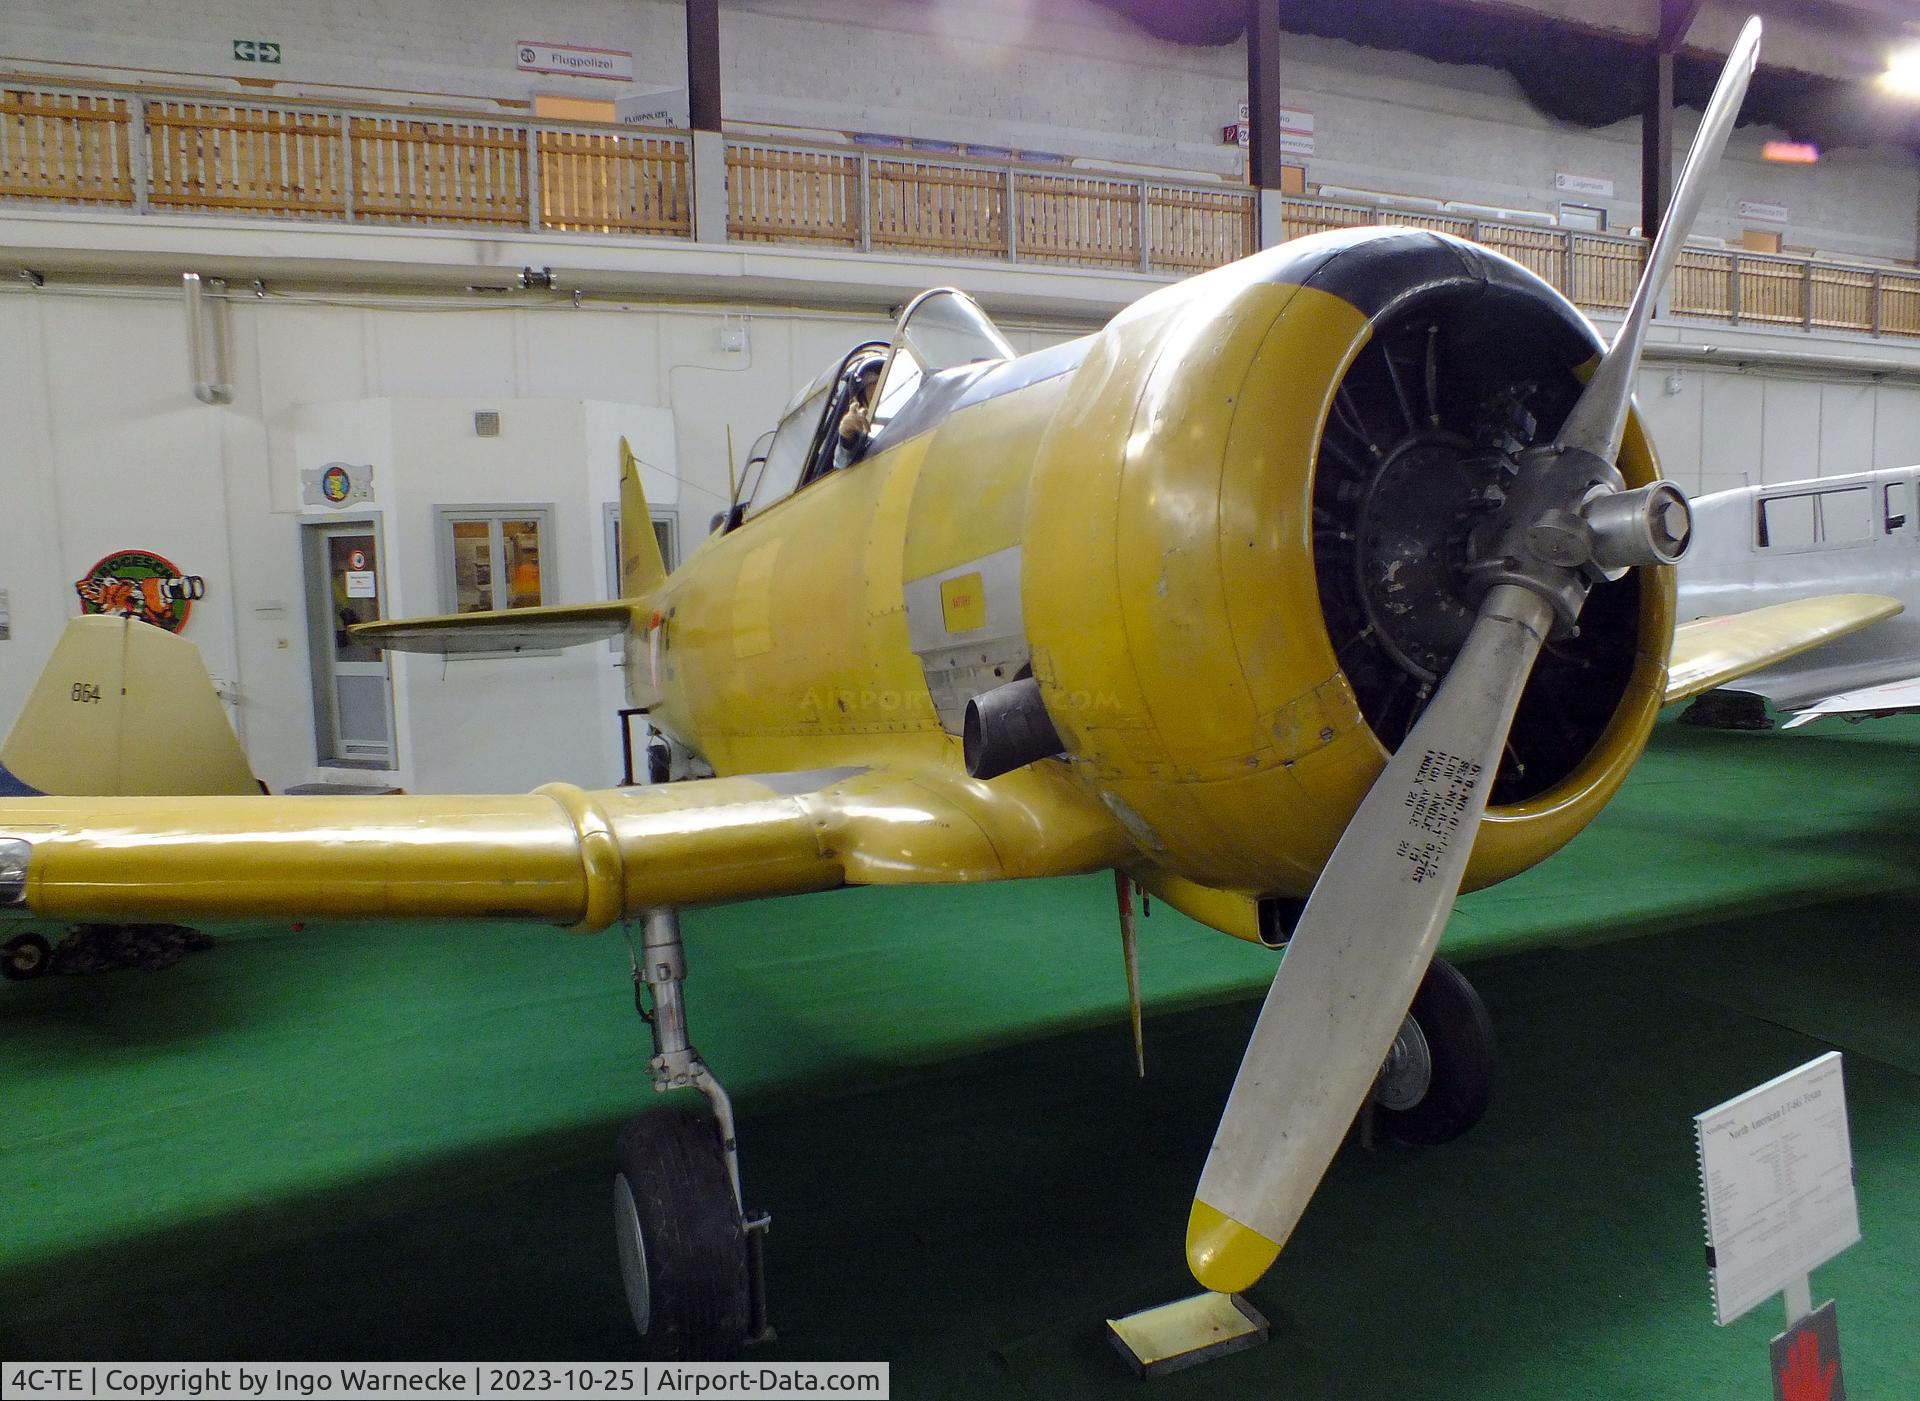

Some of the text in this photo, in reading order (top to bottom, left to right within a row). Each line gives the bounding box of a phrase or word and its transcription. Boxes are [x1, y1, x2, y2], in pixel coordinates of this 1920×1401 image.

[551, 53, 613, 70] Flugpolizei
[624, 111, 668, 125] FLUGPOLIZEI
[72, 682, 102, 704] 864
[1413, 749, 1437, 787] INDEX
[1427, 751, 1448, 783] HIGH
[1442, 755, 1461, 780] LOW
[1408, 788, 1432, 828] ANGLE
[1420, 792, 1445, 831] ANGLE
